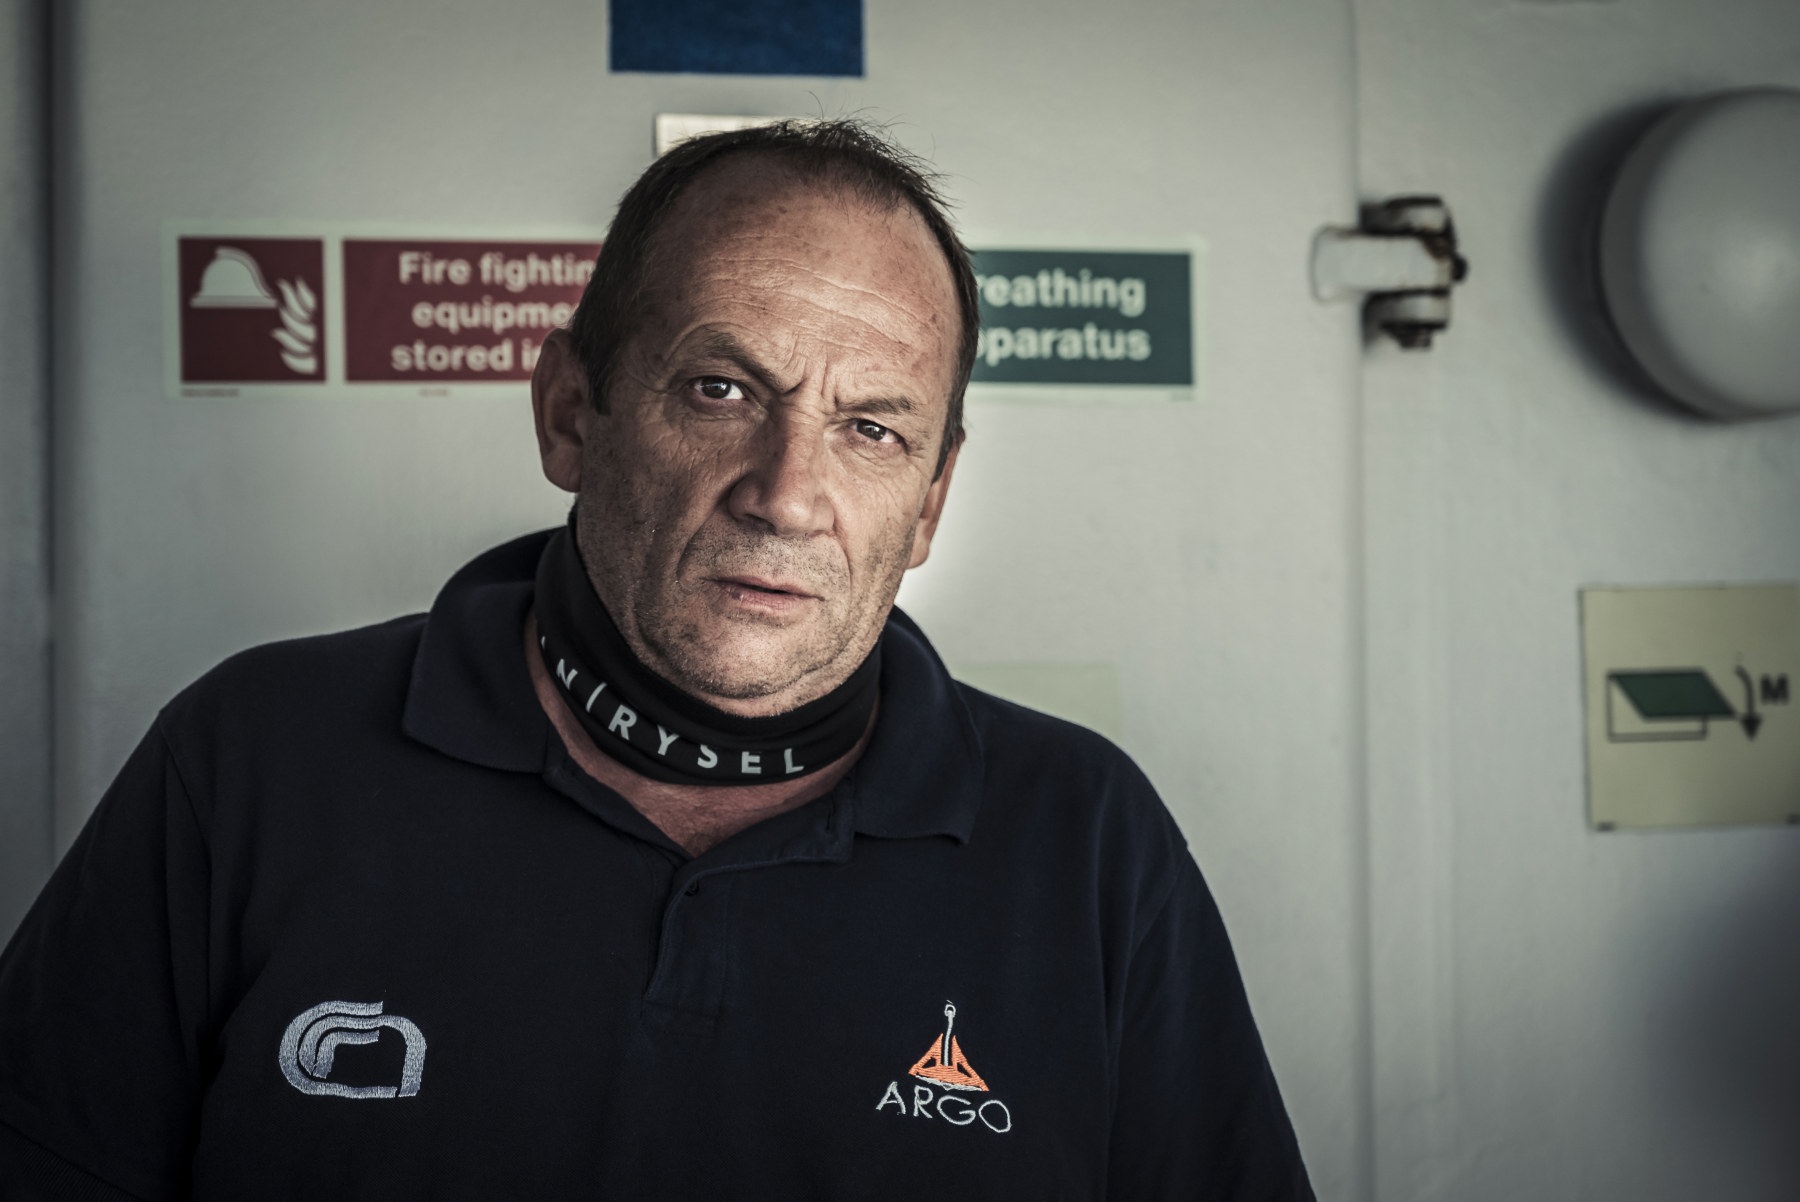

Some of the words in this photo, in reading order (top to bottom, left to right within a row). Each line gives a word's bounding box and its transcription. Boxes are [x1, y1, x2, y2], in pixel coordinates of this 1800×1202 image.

[398, 251, 472, 284] Fire
[480, 250, 597, 292] fightin
[411, 295, 578, 335] equipme
[390, 338, 515, 372] stored
[976, 322, 1152, 367] paratus
[1758, 672, 1790, 706] M
[875, 1080, 1013, 1134] ARGO
